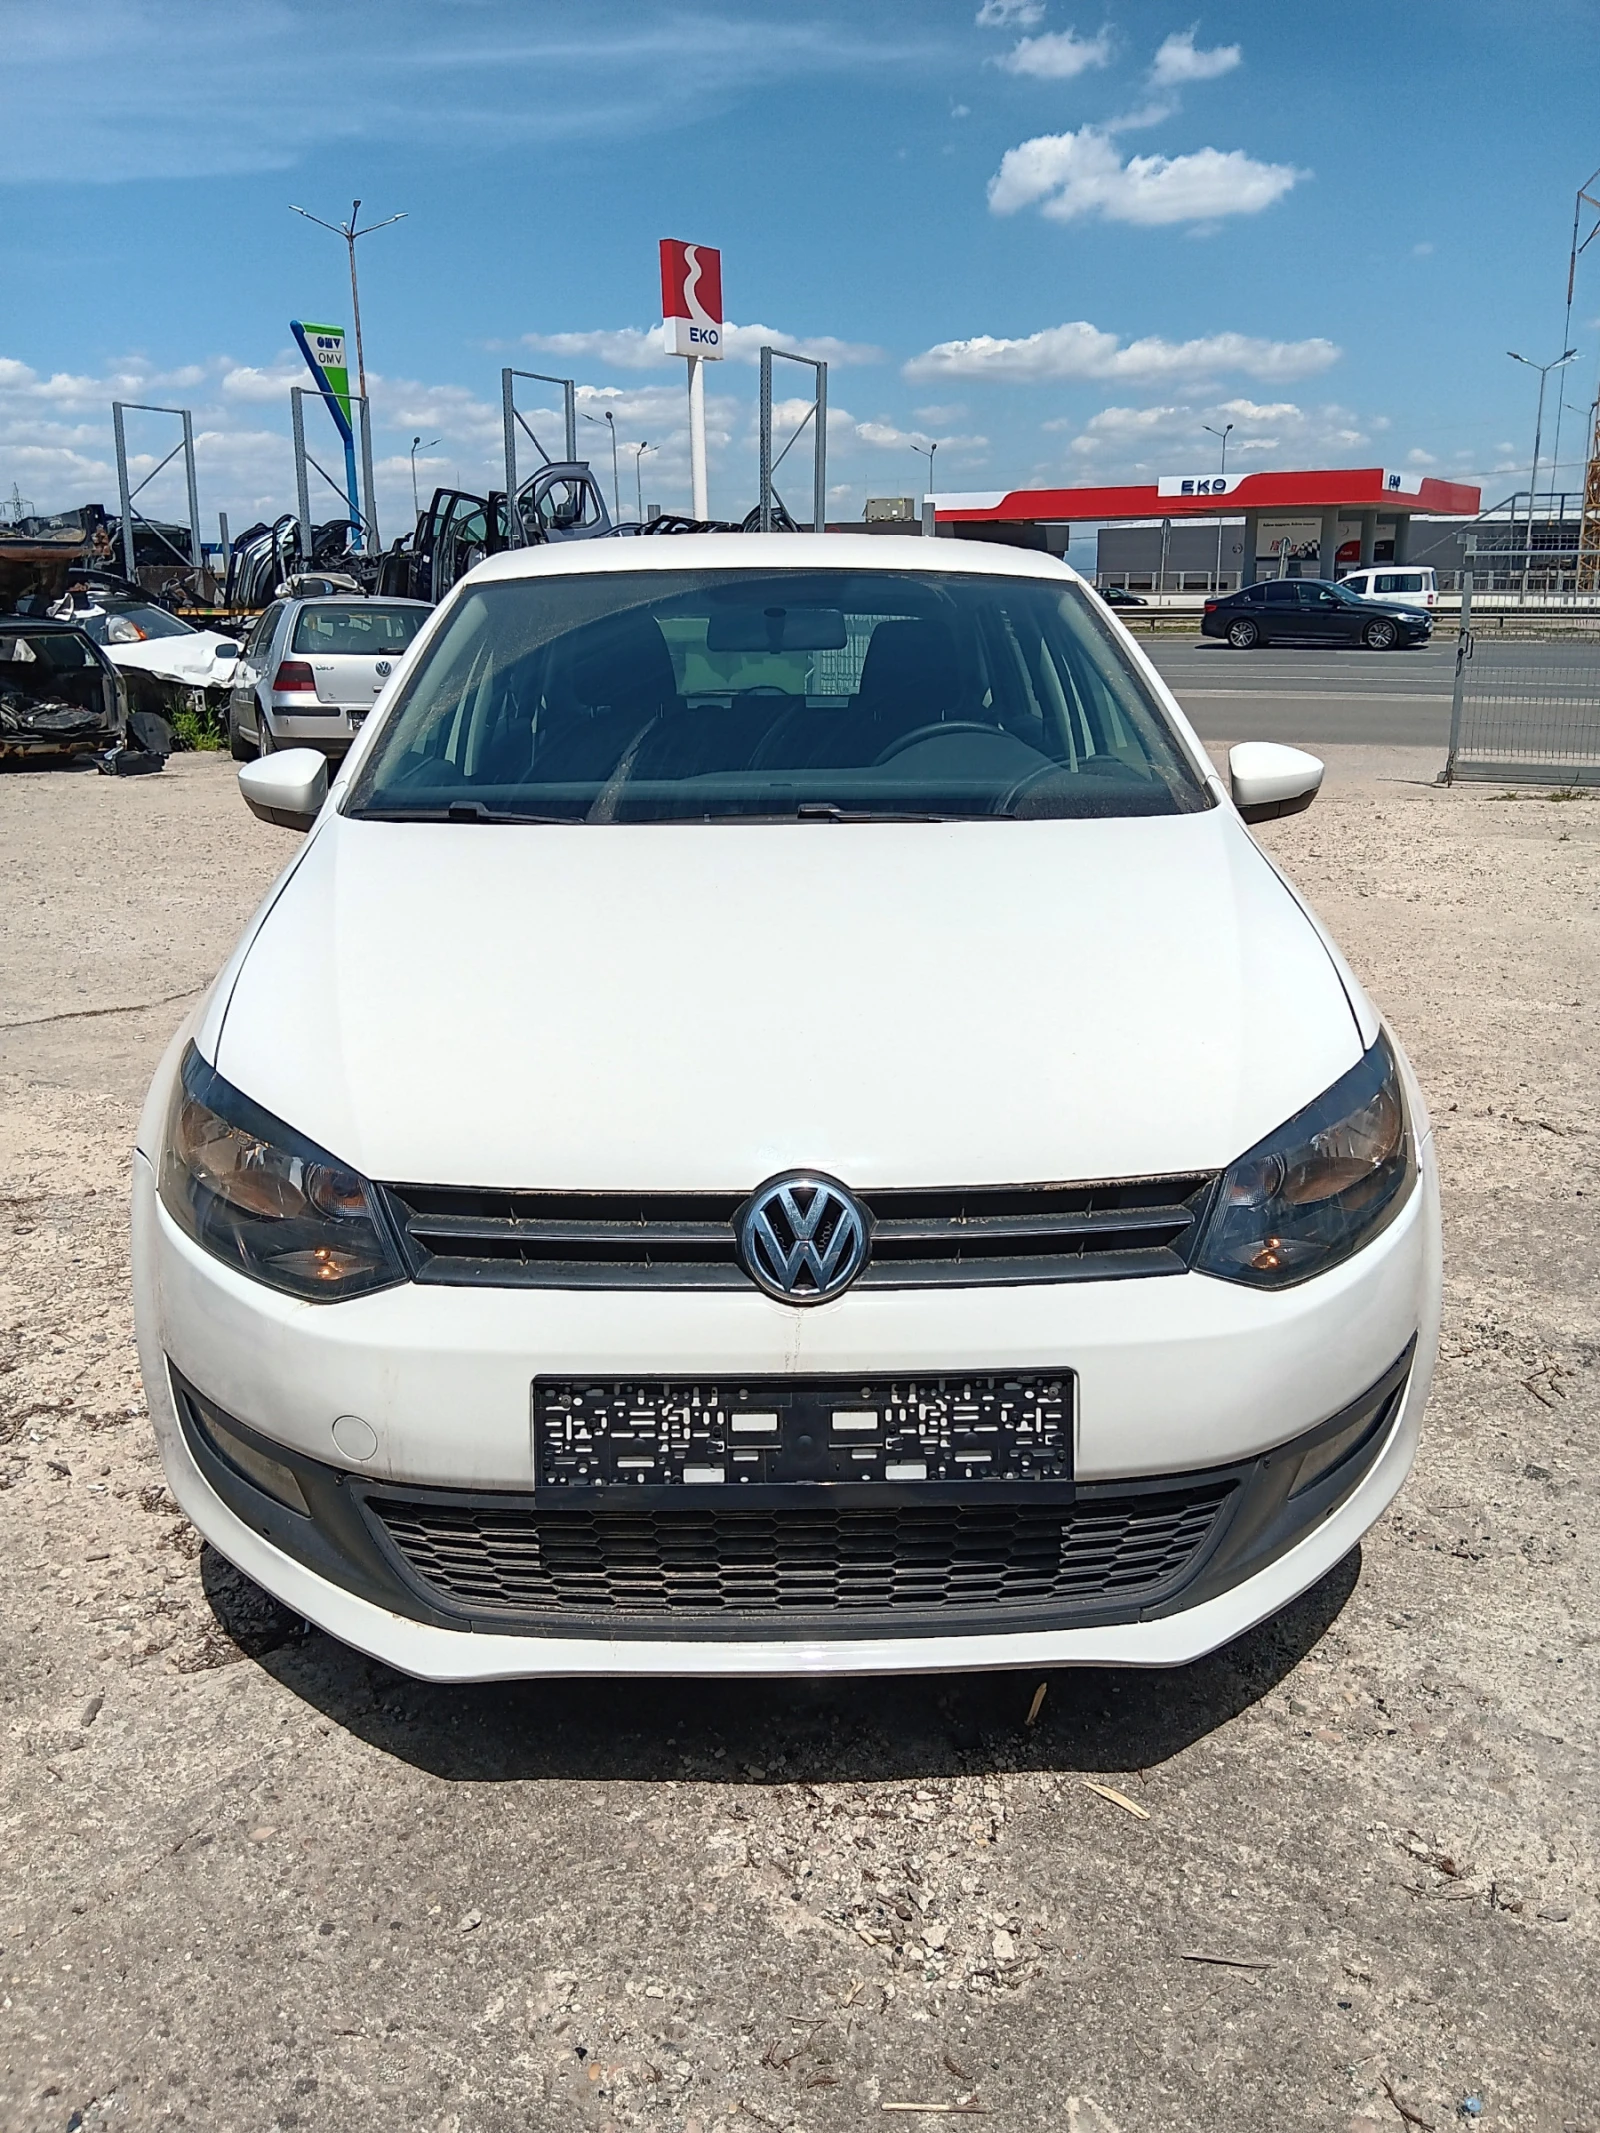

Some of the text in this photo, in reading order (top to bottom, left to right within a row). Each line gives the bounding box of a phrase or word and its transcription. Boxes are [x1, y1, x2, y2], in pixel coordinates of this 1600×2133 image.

[317, 337, 341, 349] OMV
[690, 327, 718, 345] EKO
[318, 353, 342, 364] OMV
[1181, 479, 1226, 495] EKO
